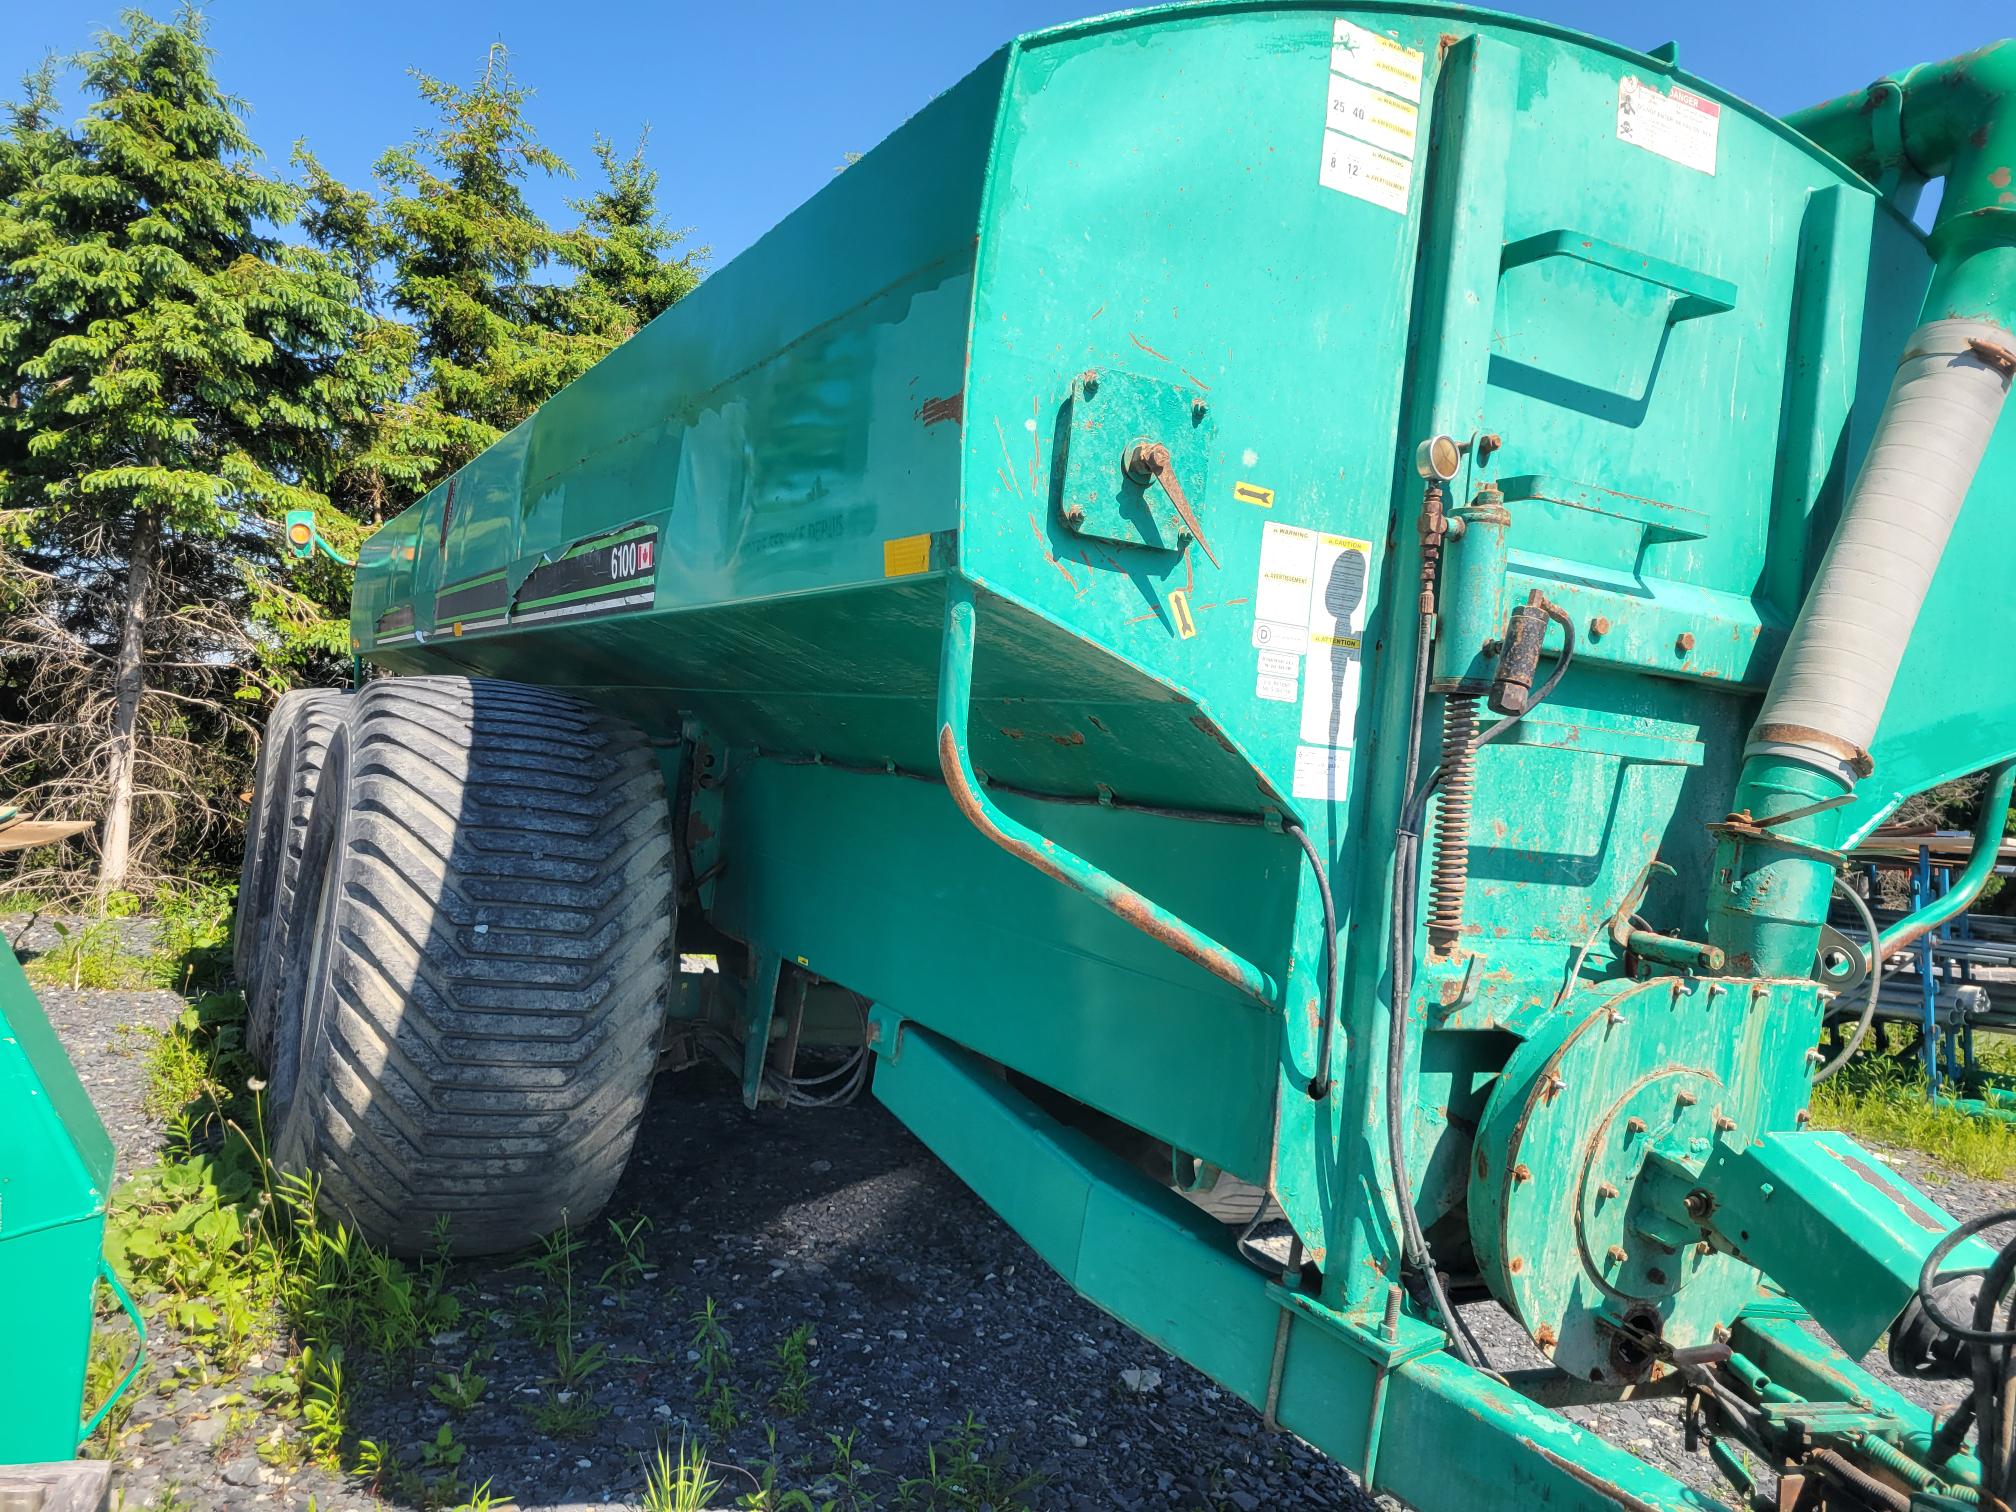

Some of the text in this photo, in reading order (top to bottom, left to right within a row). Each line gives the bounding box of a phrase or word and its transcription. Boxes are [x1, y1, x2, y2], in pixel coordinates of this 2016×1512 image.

[1333, 99, 1365, 120] 25 40
[1330, 157, 1337, 168] 8
[1348, 163, 1359, 176] 12
[1279, 528, 1309, 539] WARNING
[1334, 539, 1362, 549] CAUTION
[611, 542, 636, 580] 6100
[1260, 629, 1268, 640] D
[1320, 636, 1356, 647] ATTENTION
